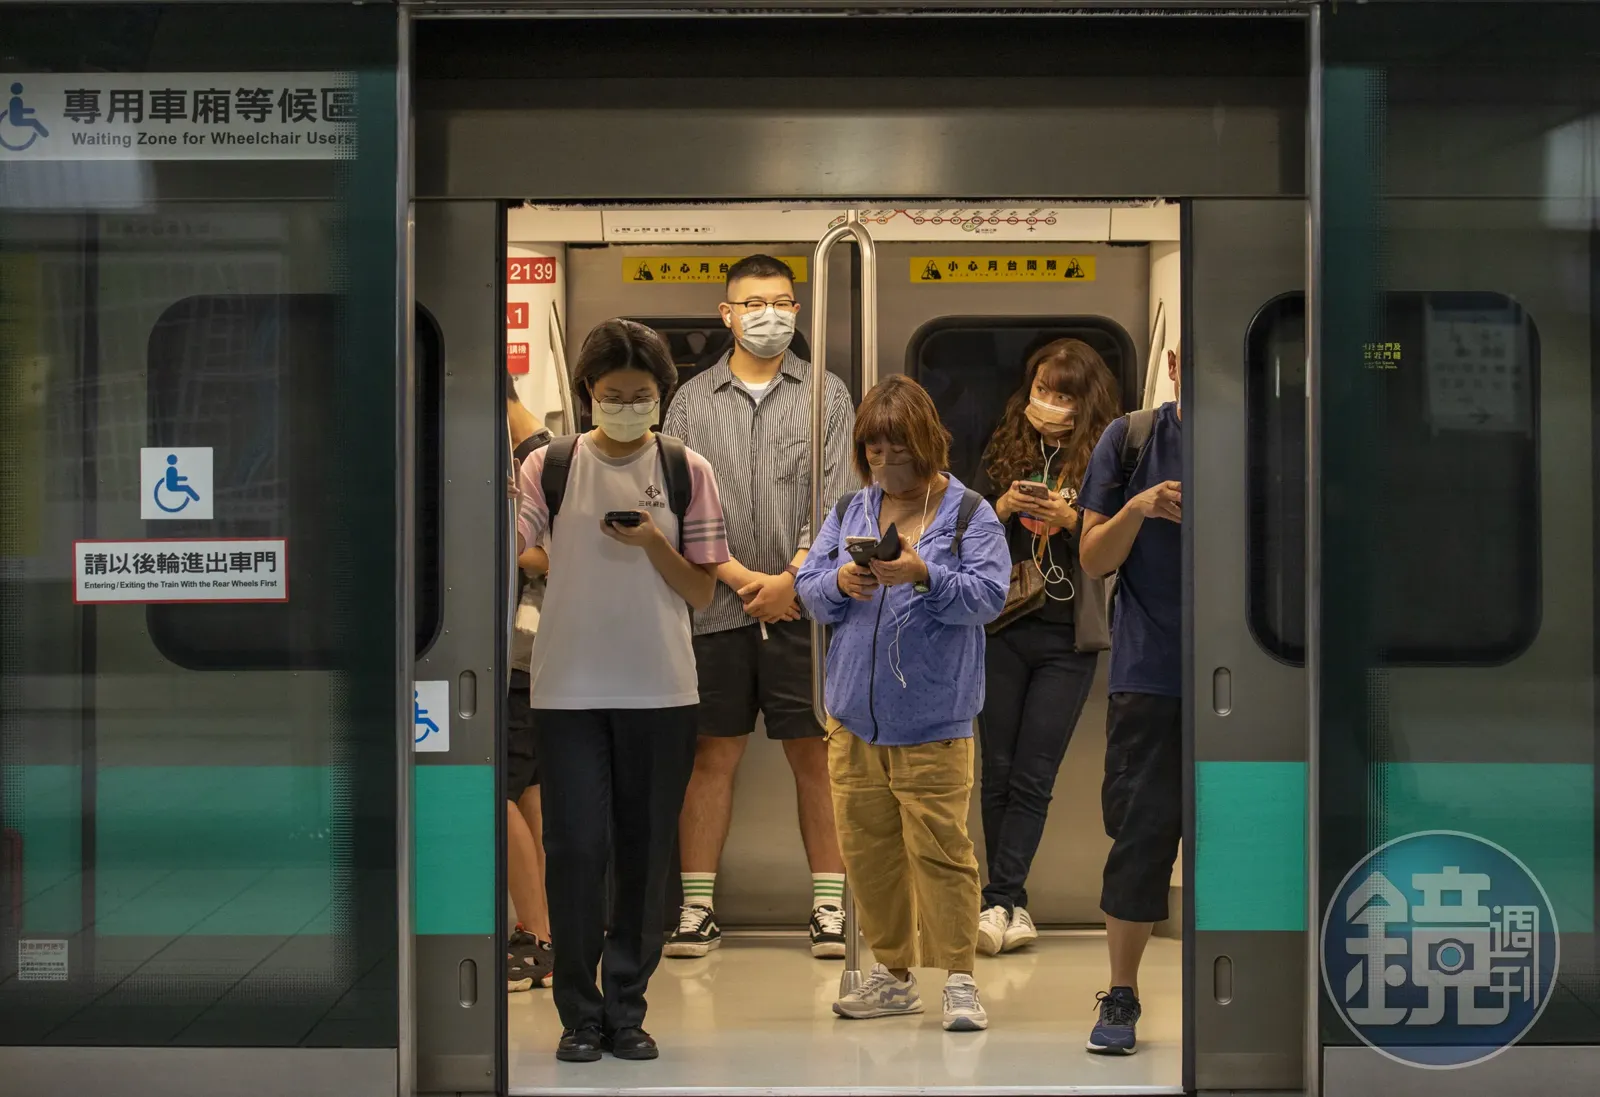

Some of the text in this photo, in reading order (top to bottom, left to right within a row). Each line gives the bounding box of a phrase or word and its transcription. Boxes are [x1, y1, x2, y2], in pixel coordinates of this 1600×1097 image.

[63, 88, 356, 125] 專用車廂等候區
[71, 131, 352, 148] Waiting Zone for Wheelchair Users
[510, 263, 553, 280] 2139
[660, 263, 728, 274] 小心月台
[948, 260, 1057, 272] 小心月台間隙
[507, 307, 523, 324] 1
[507, 344, 527, 355] 講機
[84, 551, 276, 575] 請以後輪進出車門
[147, 581, 159, 589] the
[160, 581, 179, 589] Train
[180, 581, 198, 589] With
[199, 581, 211, 589] the
[212, 580, 230, 589] Rear
[232, 580, 259, 588] Wheels
[260, 580, 278, 588] First
